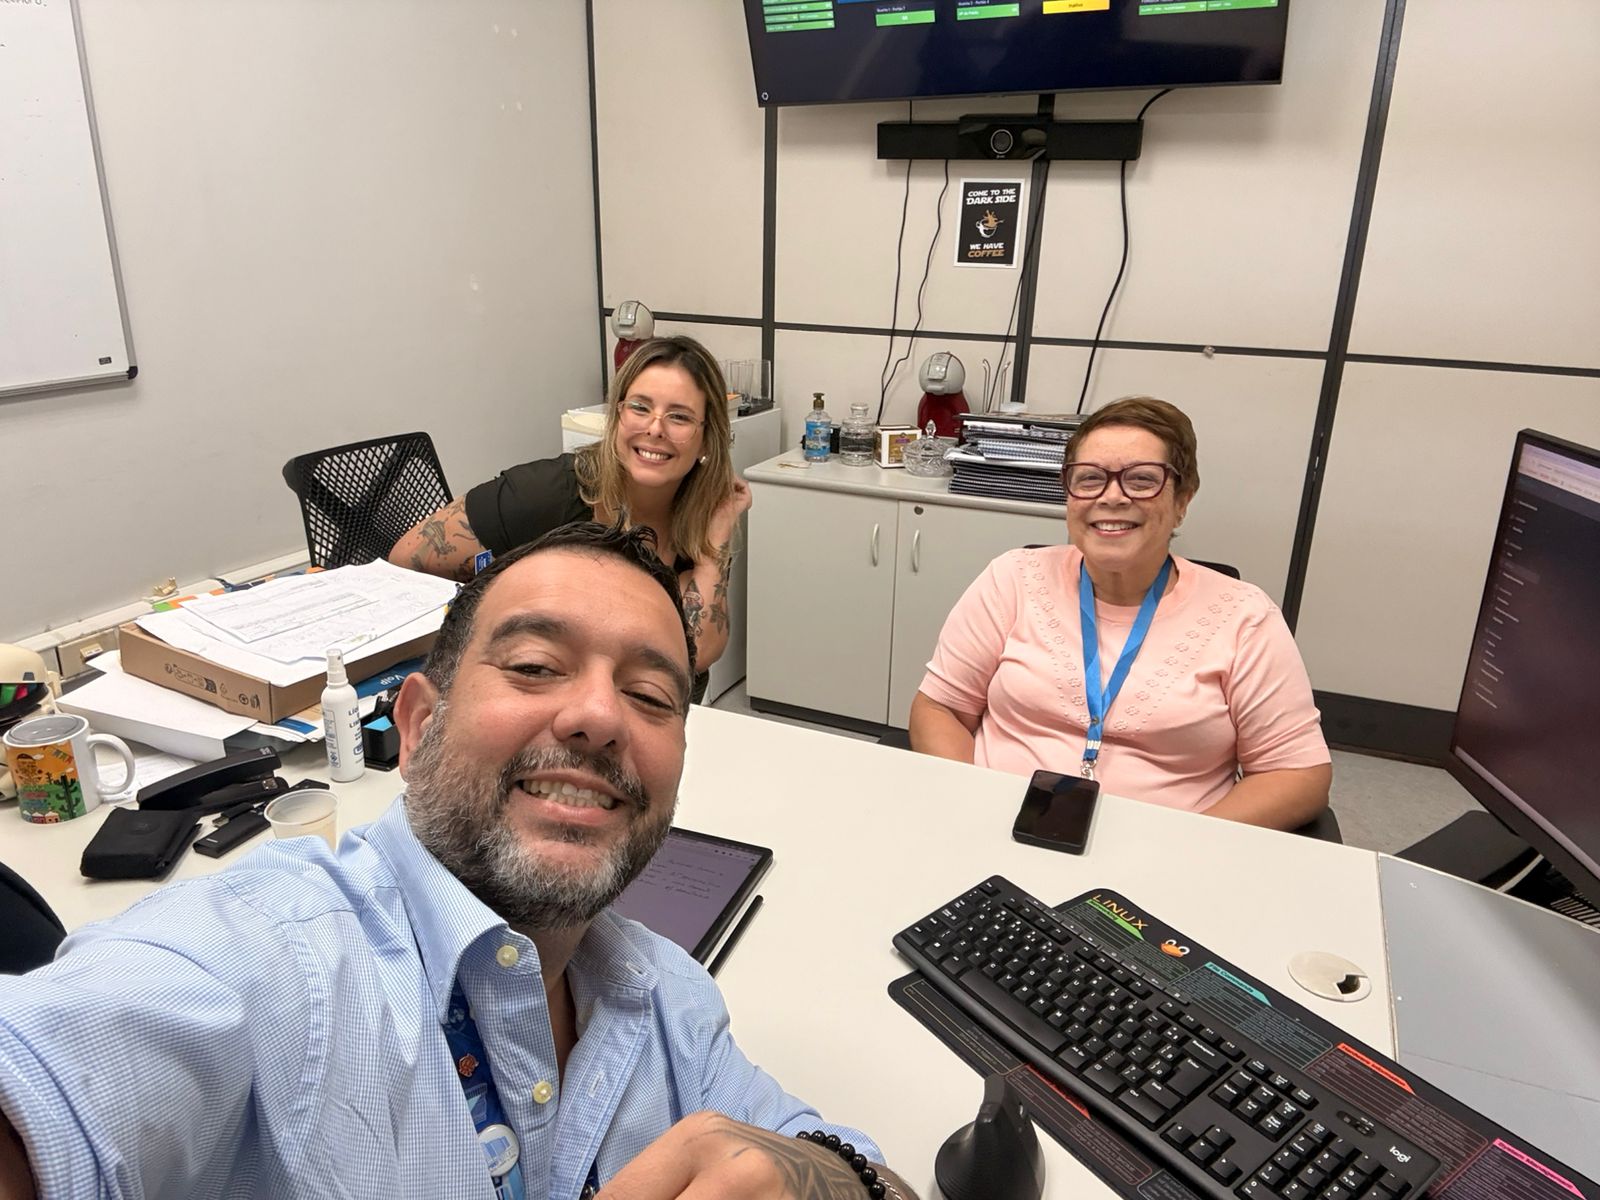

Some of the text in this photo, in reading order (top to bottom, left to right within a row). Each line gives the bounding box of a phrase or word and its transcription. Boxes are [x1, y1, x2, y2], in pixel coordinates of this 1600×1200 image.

[966, 195, 1016, 205] DARK SIDE
[968, 250, 1005, 258] COFFEE
[1092, 894, 1148, 930] LINUX
[1220, 970, 1253, 992] Commands
[1192, 1040, 1215, 1056] Backspace
[1187, 1059, 1199, 1068] Enter
[1240, 1071, 1252, 1081] Insert
[1152, 1082, 1162, 1090] Shift
[1224, 1084, 1237, 1094] Delete
[1261, 1086, 1274, 1096] Home
[1248, 1100, 1257, 1108] End
[1390, 1145, 1412, 1163] logi
